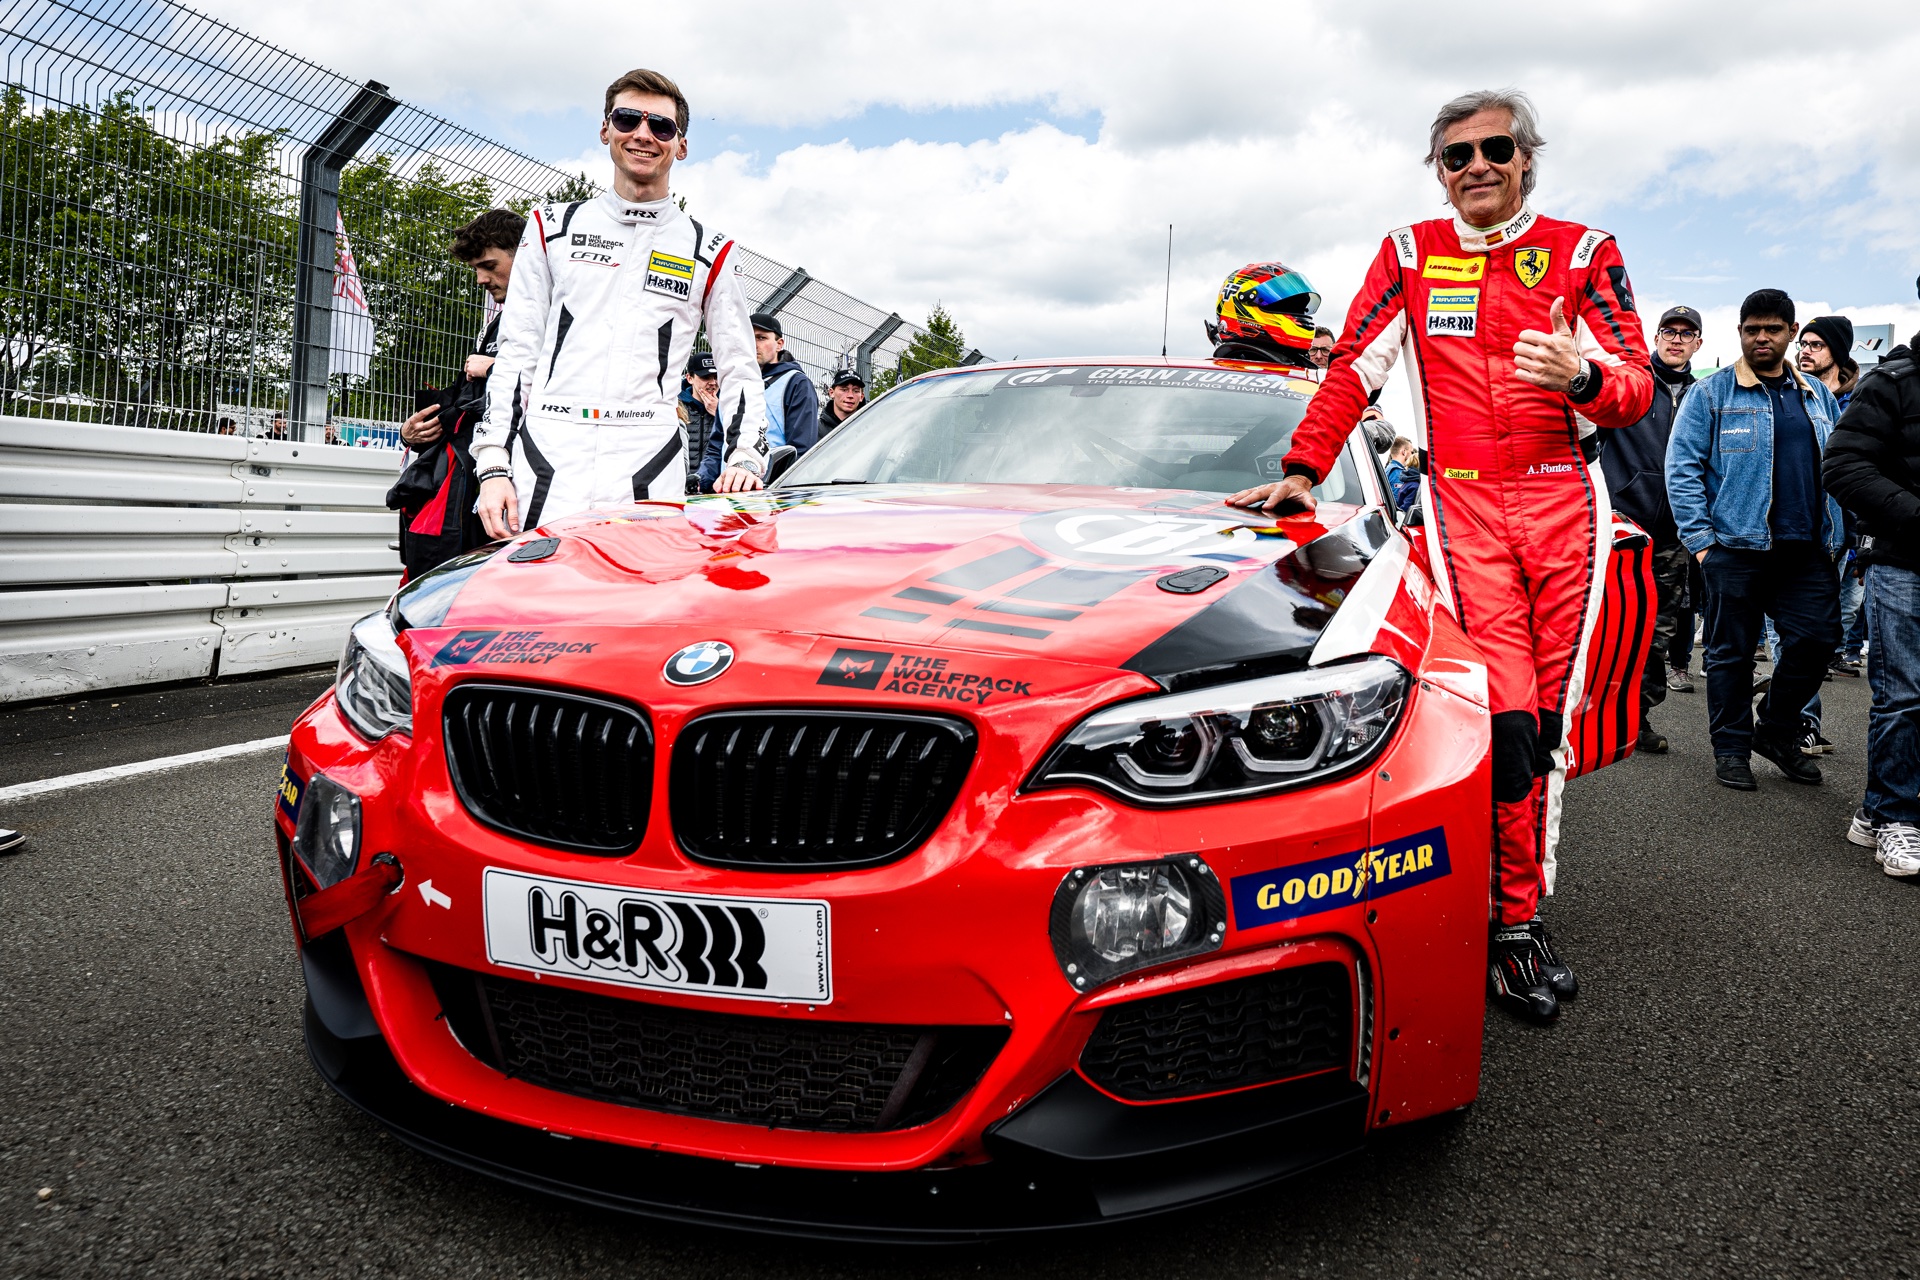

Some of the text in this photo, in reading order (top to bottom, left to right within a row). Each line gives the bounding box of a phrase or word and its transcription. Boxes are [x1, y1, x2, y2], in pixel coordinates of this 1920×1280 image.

[625, 209, 659, 219] HRX
[1505, 211, 1532, 238] FONTES
[588, 238, 624, 248] WOLFPACK
[1398, 234, 1413, 259] Sabelt
[1577, 235, 1597, 261] Sabelt
[571, 251, 612, 263] CFTR
[655, 259, 690, 272] RAVENOL
[1088, 368, 1297, 392] GRAN TURISM
[1160, 380, 1222, 389] DRIVING
[541, 404, 571, 414] HRX
[616, 410, 655, 420] Mulready
[1448, 469, 1474, 479] Sabelt
[502, 631, 544, 641] THE
[491, 642, 600, 654] WOLFPACK
[474, 652, 560, 665] AGENCY
[900, 655, 949, 670] THE
[892, 667, 1034, 696] WOLFPACK
[883, 681, 993, 705] AGENCY
[1256, 844, 1434, 910] GOODYEAR
[528, 885, 682, 982] H&R
[815, 910, 825, 993] www.h-r.com
